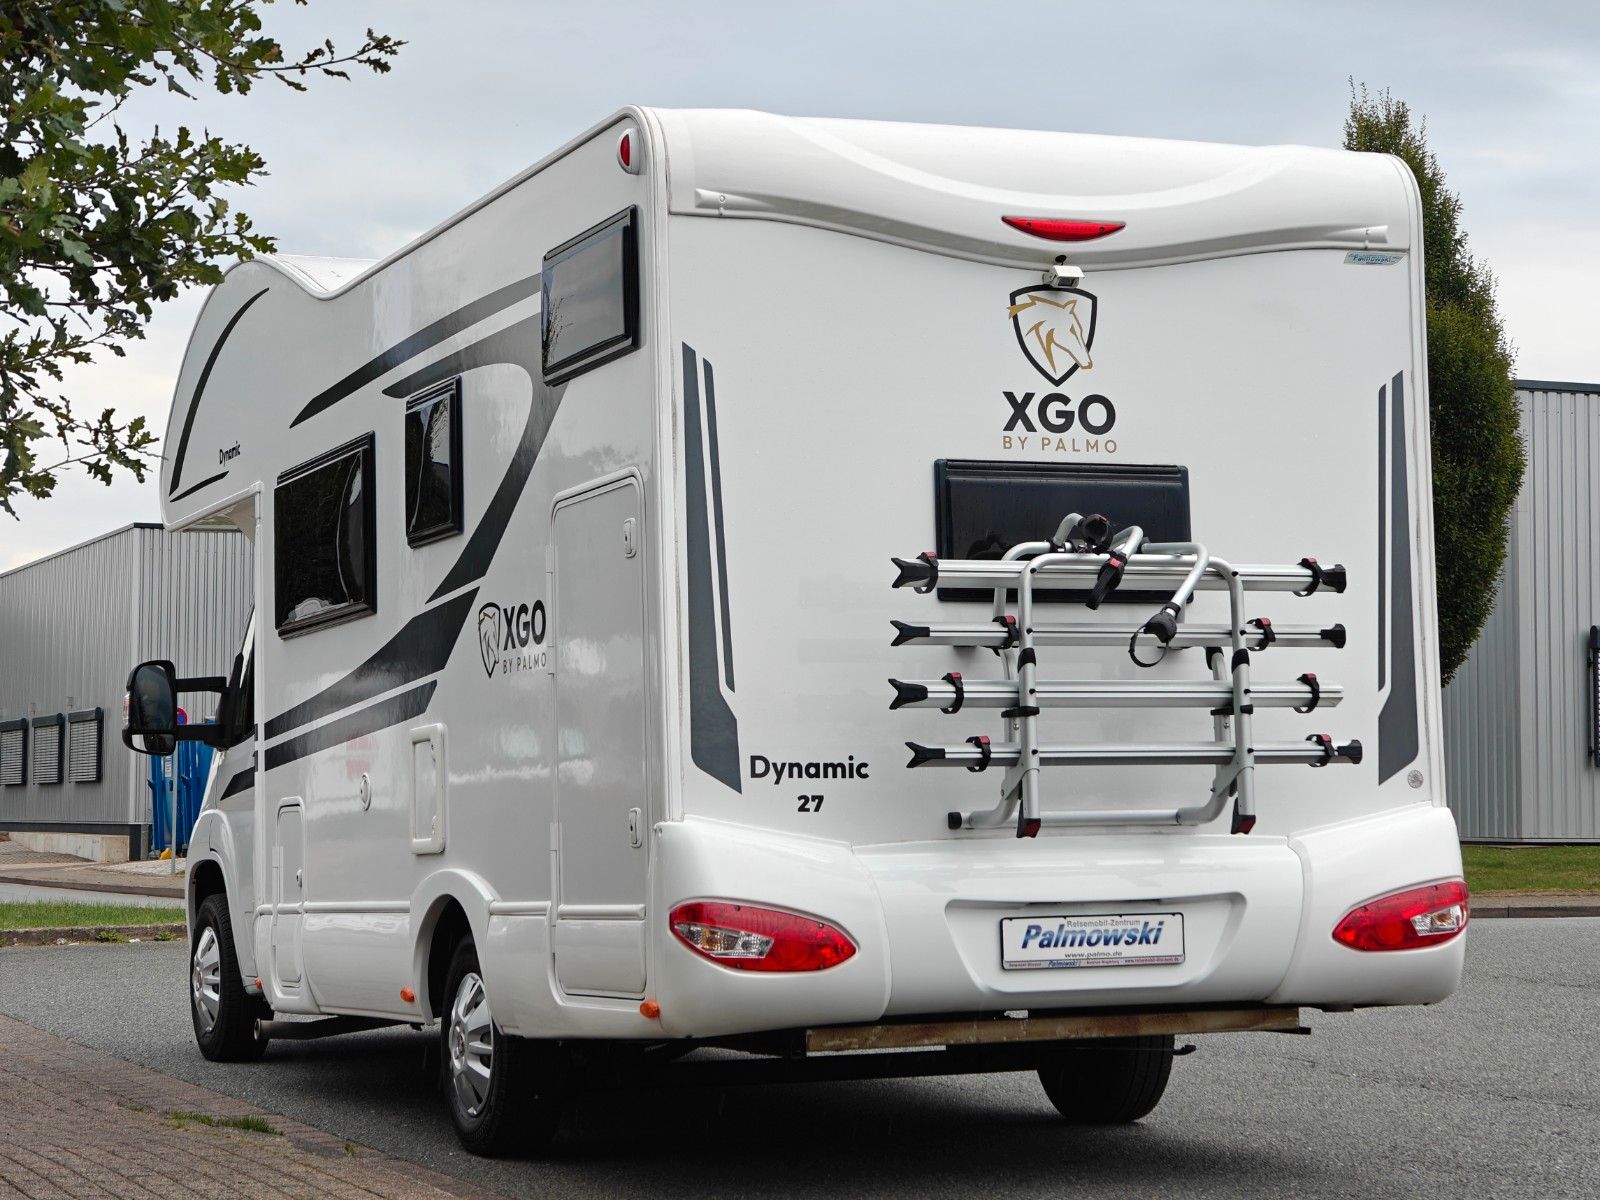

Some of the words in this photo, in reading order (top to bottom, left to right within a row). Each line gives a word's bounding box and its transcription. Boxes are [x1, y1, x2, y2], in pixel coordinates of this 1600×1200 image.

[1002, 391, 1116, 436] XGO
[219, 440, 241, 467] Dynamic
[1002, 435, 1028, 450] BY
[1041, 437, 1117, 454] PALMO
[503, 599, 547, 651] XGO
[503, 658, 513, 674] BY
[516, 652, 547, 672] PALMO
[750, 755, 870, 785] Dynamic
[797, 794, 824, 812] 27
[1021, 921, 1165, 949] Palmowski
[1066, 918, 1141, 928] Reisemobil-Zentrum
[1064, 950, 1123, 959] www.palmo.de
